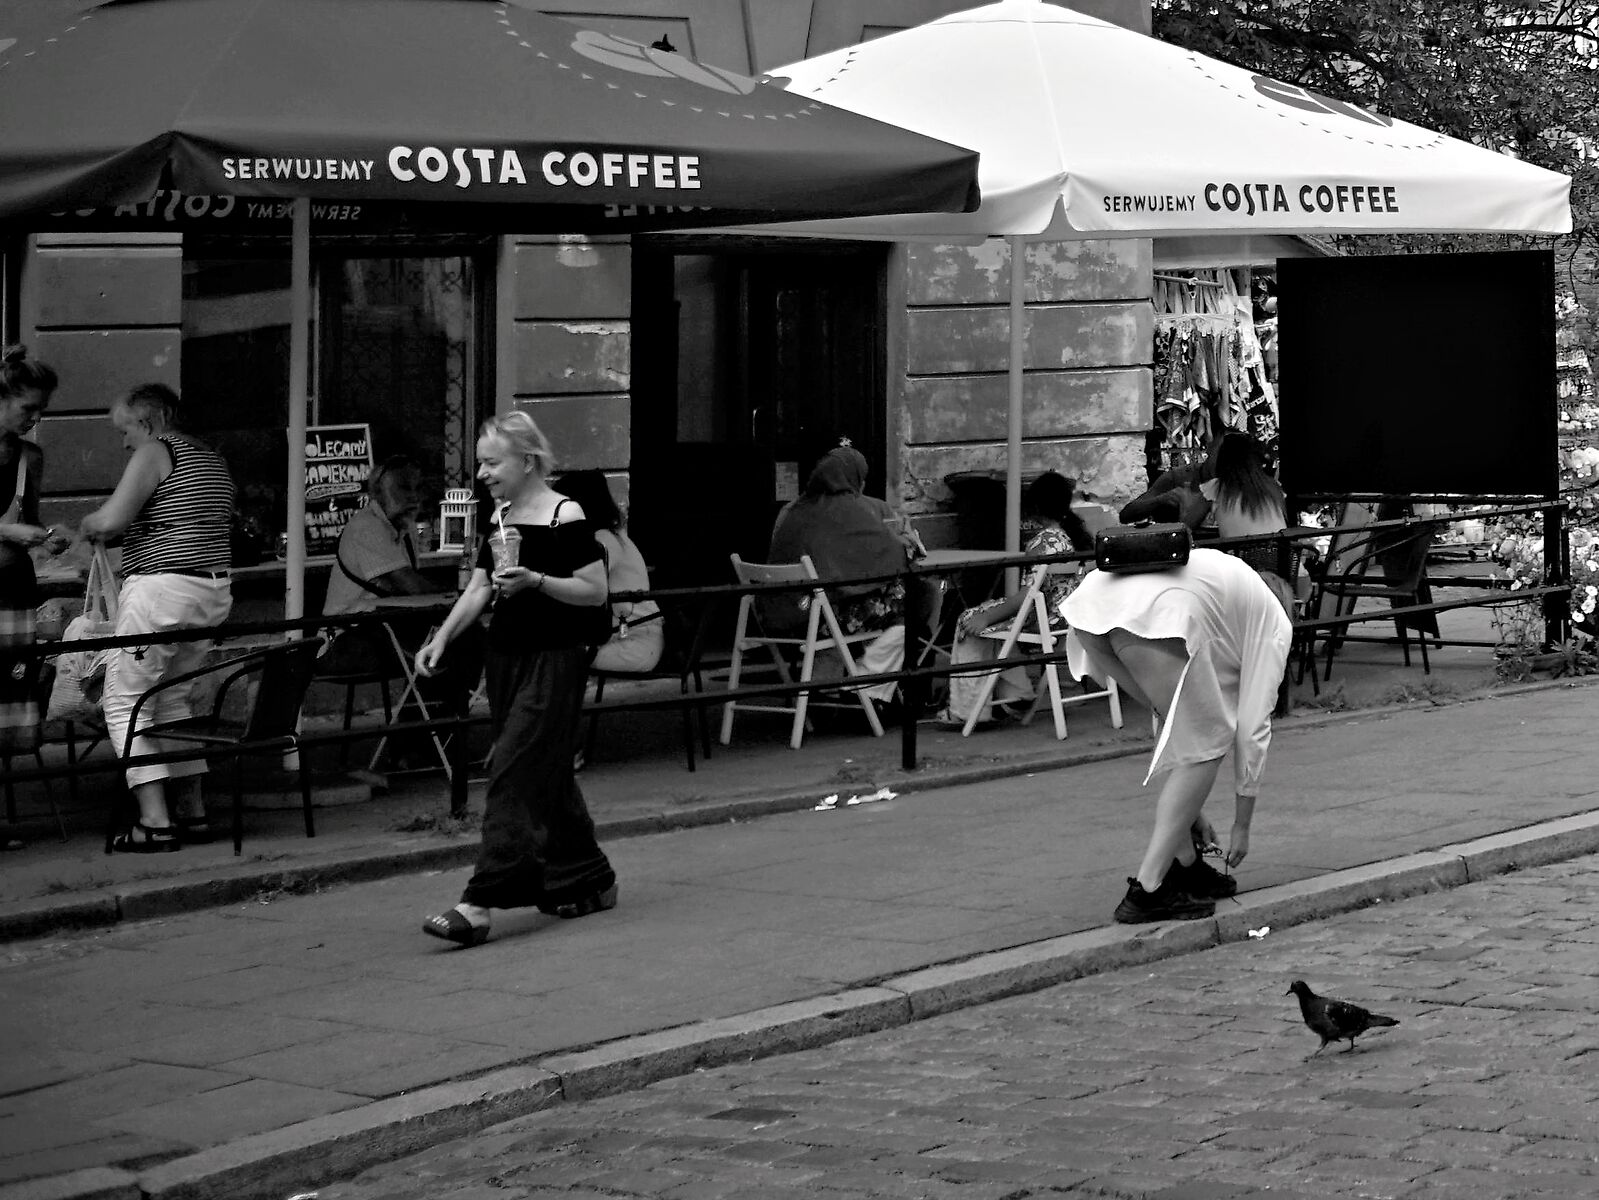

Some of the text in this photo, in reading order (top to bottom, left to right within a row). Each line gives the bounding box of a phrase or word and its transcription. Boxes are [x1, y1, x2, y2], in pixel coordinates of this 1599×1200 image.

[222, 145, 701, 189] SERWUJEMY COSTA COFFEE
[1103, 182, 1400, 217] SERWUJEMY COSTA COFFEE
[304, 434, 367, 457] OLECAMY
